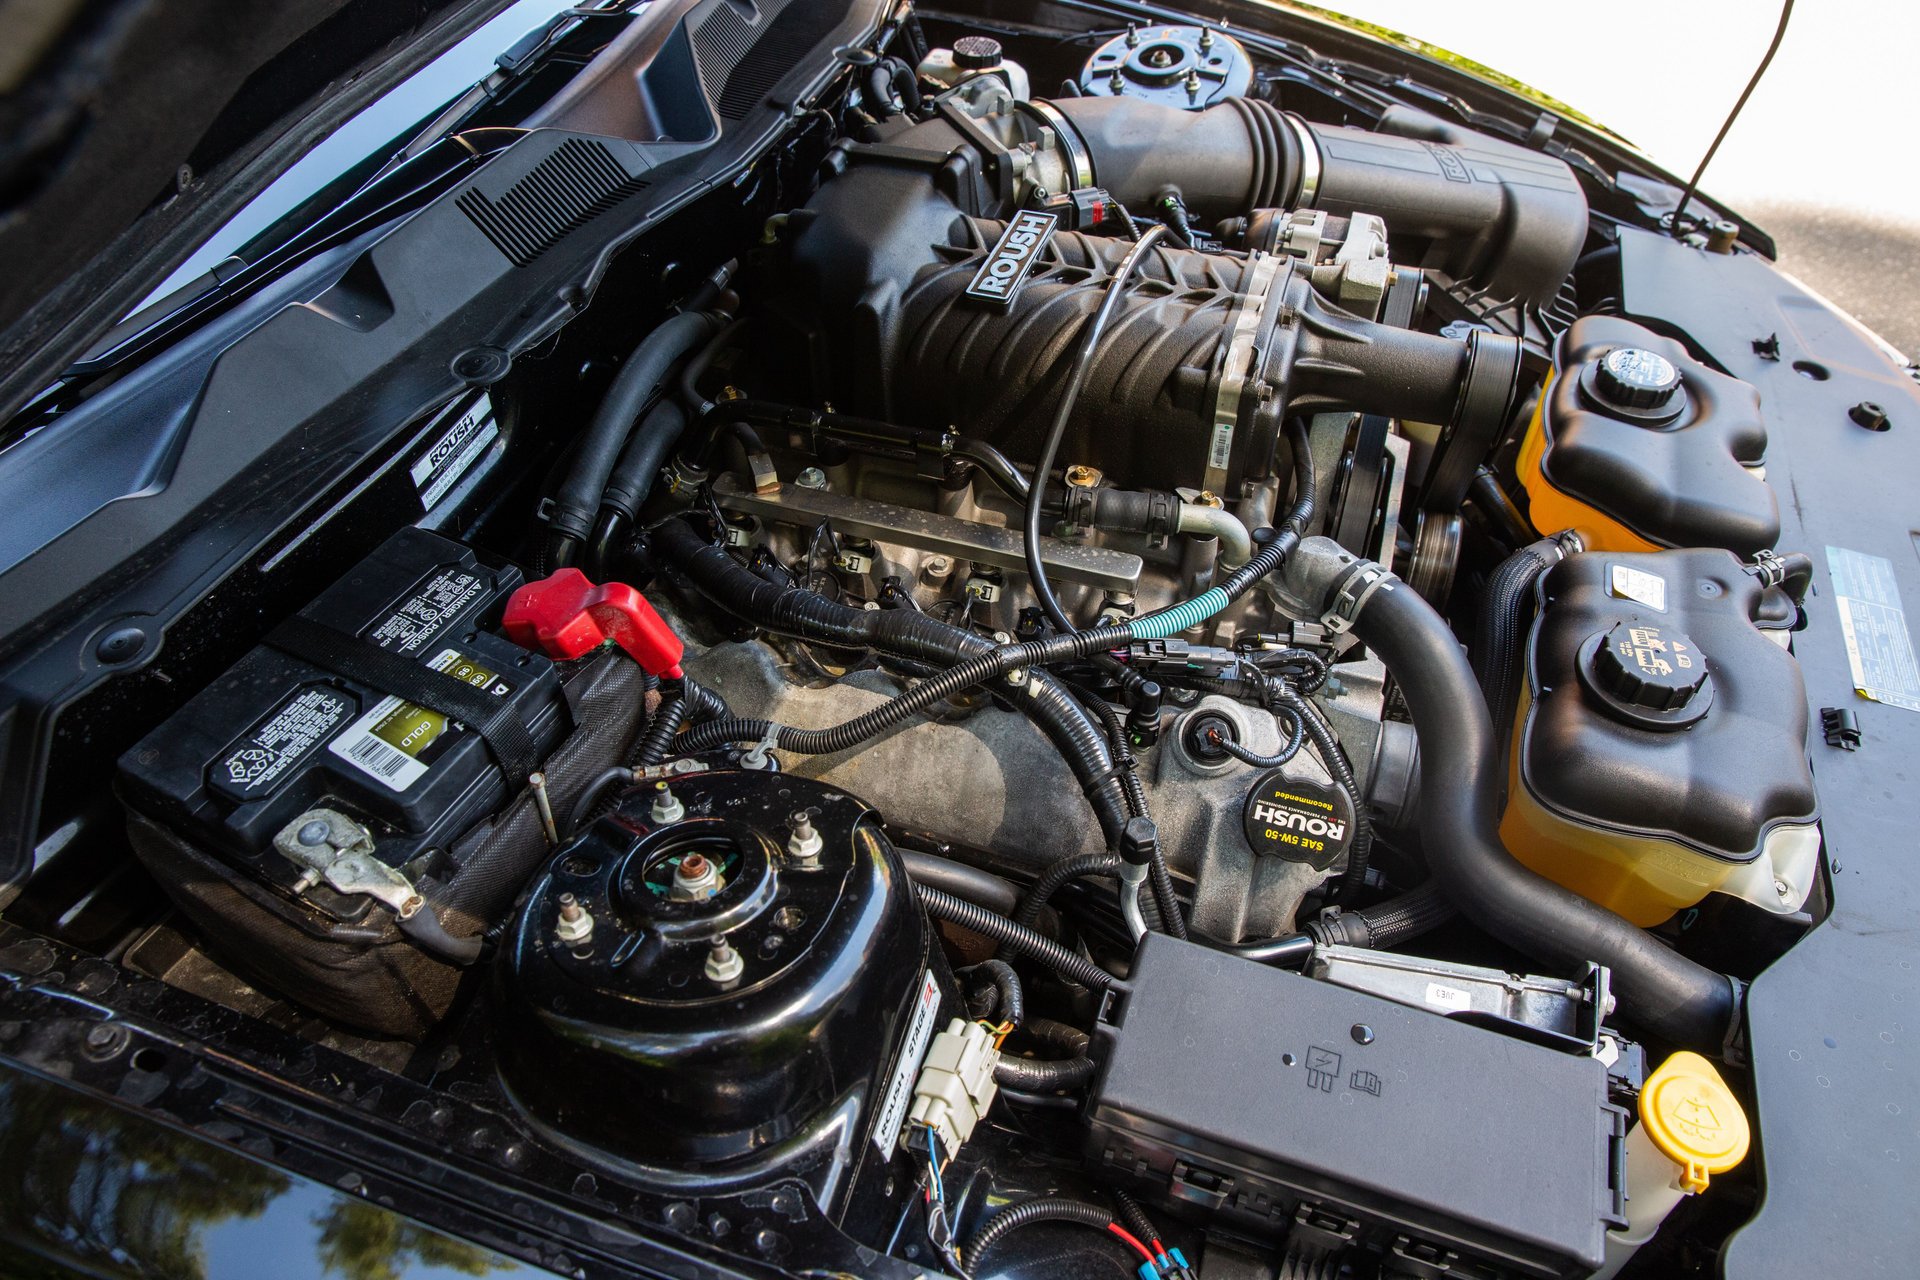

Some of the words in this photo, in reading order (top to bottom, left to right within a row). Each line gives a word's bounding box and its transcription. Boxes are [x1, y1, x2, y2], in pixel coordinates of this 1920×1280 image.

[978, 215, 1048, 293] ROUSH
[430, 415, 474, 468] ROUSH
[441, 589, 476, 619] DANGER
[405, 622, 439, 651] POISON
[400, 719, 432, 749] GOLD
[1257, 799, 1287, 810] ENGINEERING
[1274, 791, 1333, 811] Recommended
[1288, 806, 1320, 818] PERFORMANCE
[1253, 804, 1344, 840] ROUSH
[1264, 828, 1299, 845] 5W-50
[1300, 837, 1324, 851] SAE
[907, 1003, 926, 1058] STAGE
[880, 1072, 905, 1136] ROUSH
